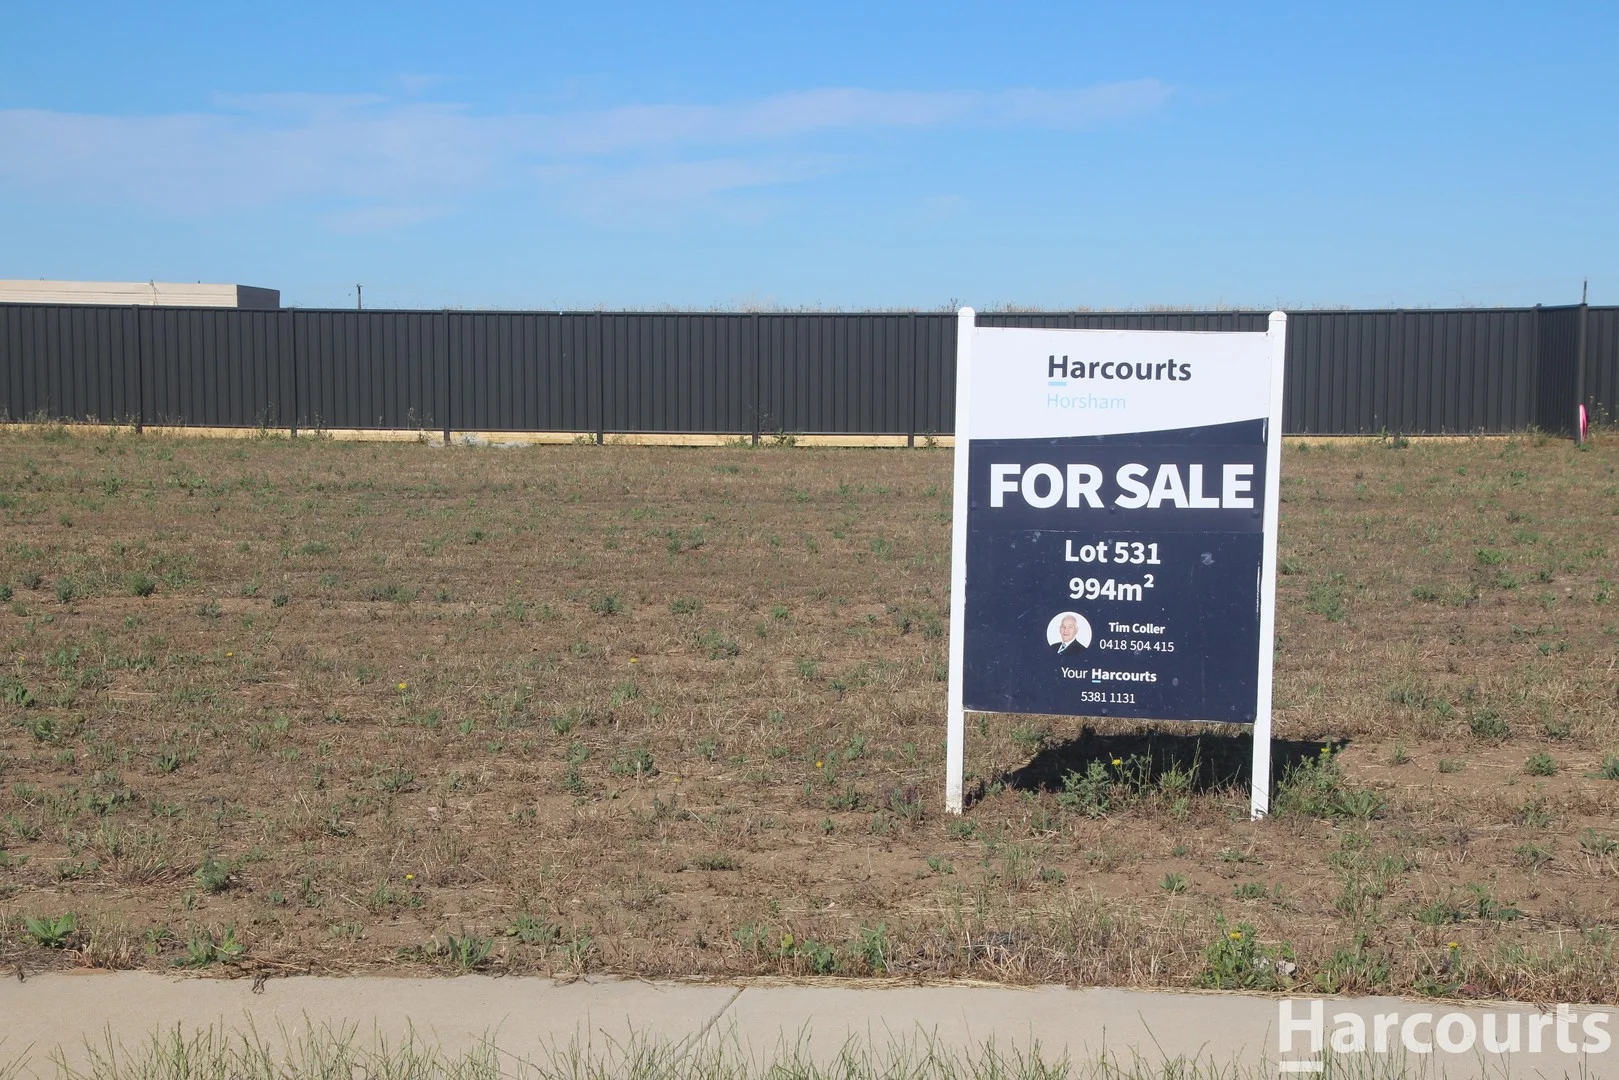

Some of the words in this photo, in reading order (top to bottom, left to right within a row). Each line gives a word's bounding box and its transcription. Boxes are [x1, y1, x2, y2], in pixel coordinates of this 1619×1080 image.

[1048, 355, 1192, 382] Harcourts
[1046, 393, 1126, 410] Horsham
[990, 463, 1104, 509] FOR
[1114, 463, 1254, 509] SALE
[1065, 539, 1108, 563] Lot
[1113, 541, 1161, 565] 531
[1108, 622, 1130, 633] Tim
[1132, 623, 1166, 634] Coller
[1099, 639, 1127, 651] 0418
[1130, 640, 1151, 651] 504
[1153, 641, 1175, 652] 415
[1061, 667, 1088, 679] Your
[1091, 668, 1157, 682] Harcourts
[1081, 691, 1107, 703] 5381
[1109, 693, 1136, 704] 1131
